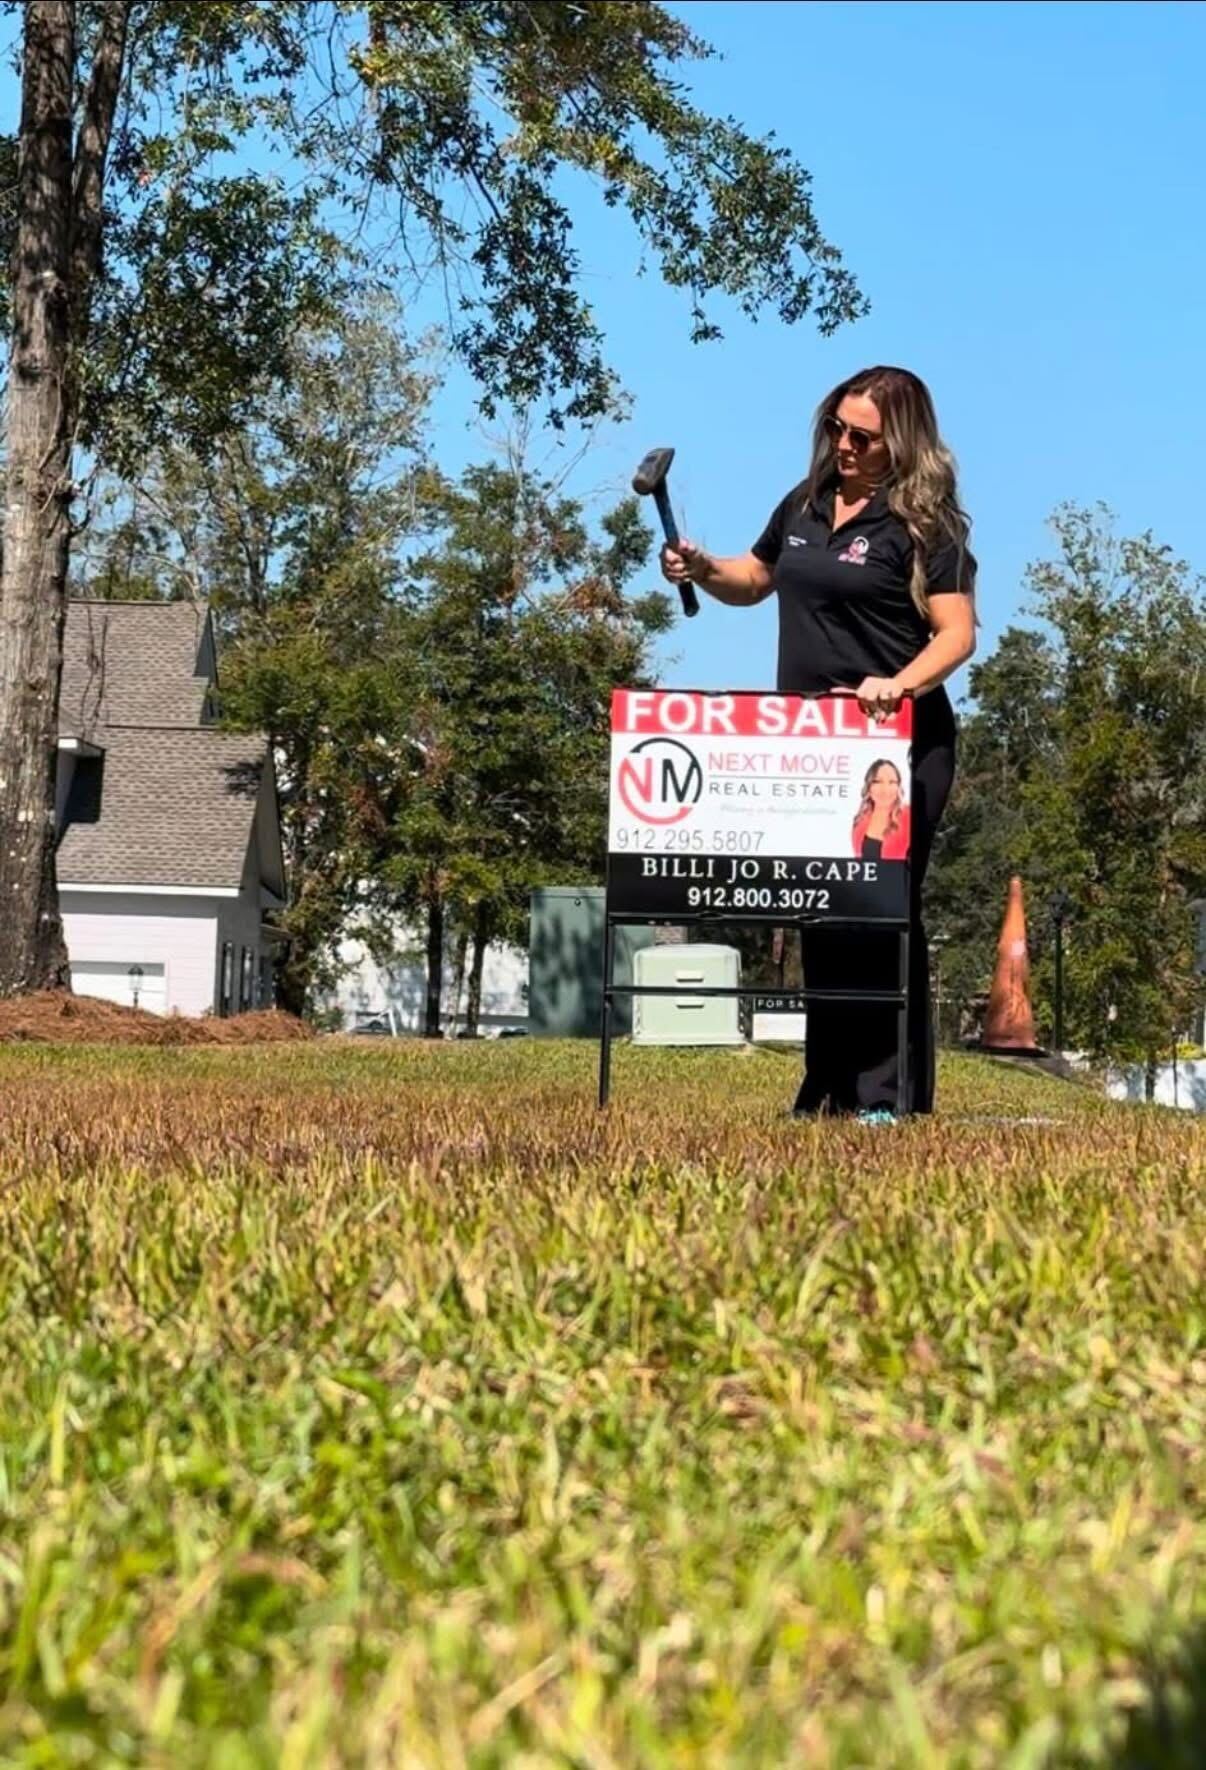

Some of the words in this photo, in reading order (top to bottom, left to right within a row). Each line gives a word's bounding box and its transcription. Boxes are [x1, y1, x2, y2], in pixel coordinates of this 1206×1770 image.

[626, 692, 737, 733] FOR
[708, 752, 771, 772] NEXT
[780, 754, 850, 775] MOVE
[709, 782, 761, 796] REAL
[771, 783, 849, 799] ESTATE
[641, 857, 715, 878] BILLI
[727, 860, 760, 884] JO
[773, 862, 797, 880] R.
[805, 862, 878, 881] CAPE
[687, 887, 830, 909] 912.800.3072
[758, 999, 784, 1009] FOR
[789, 1000, 805, 1009] SA
